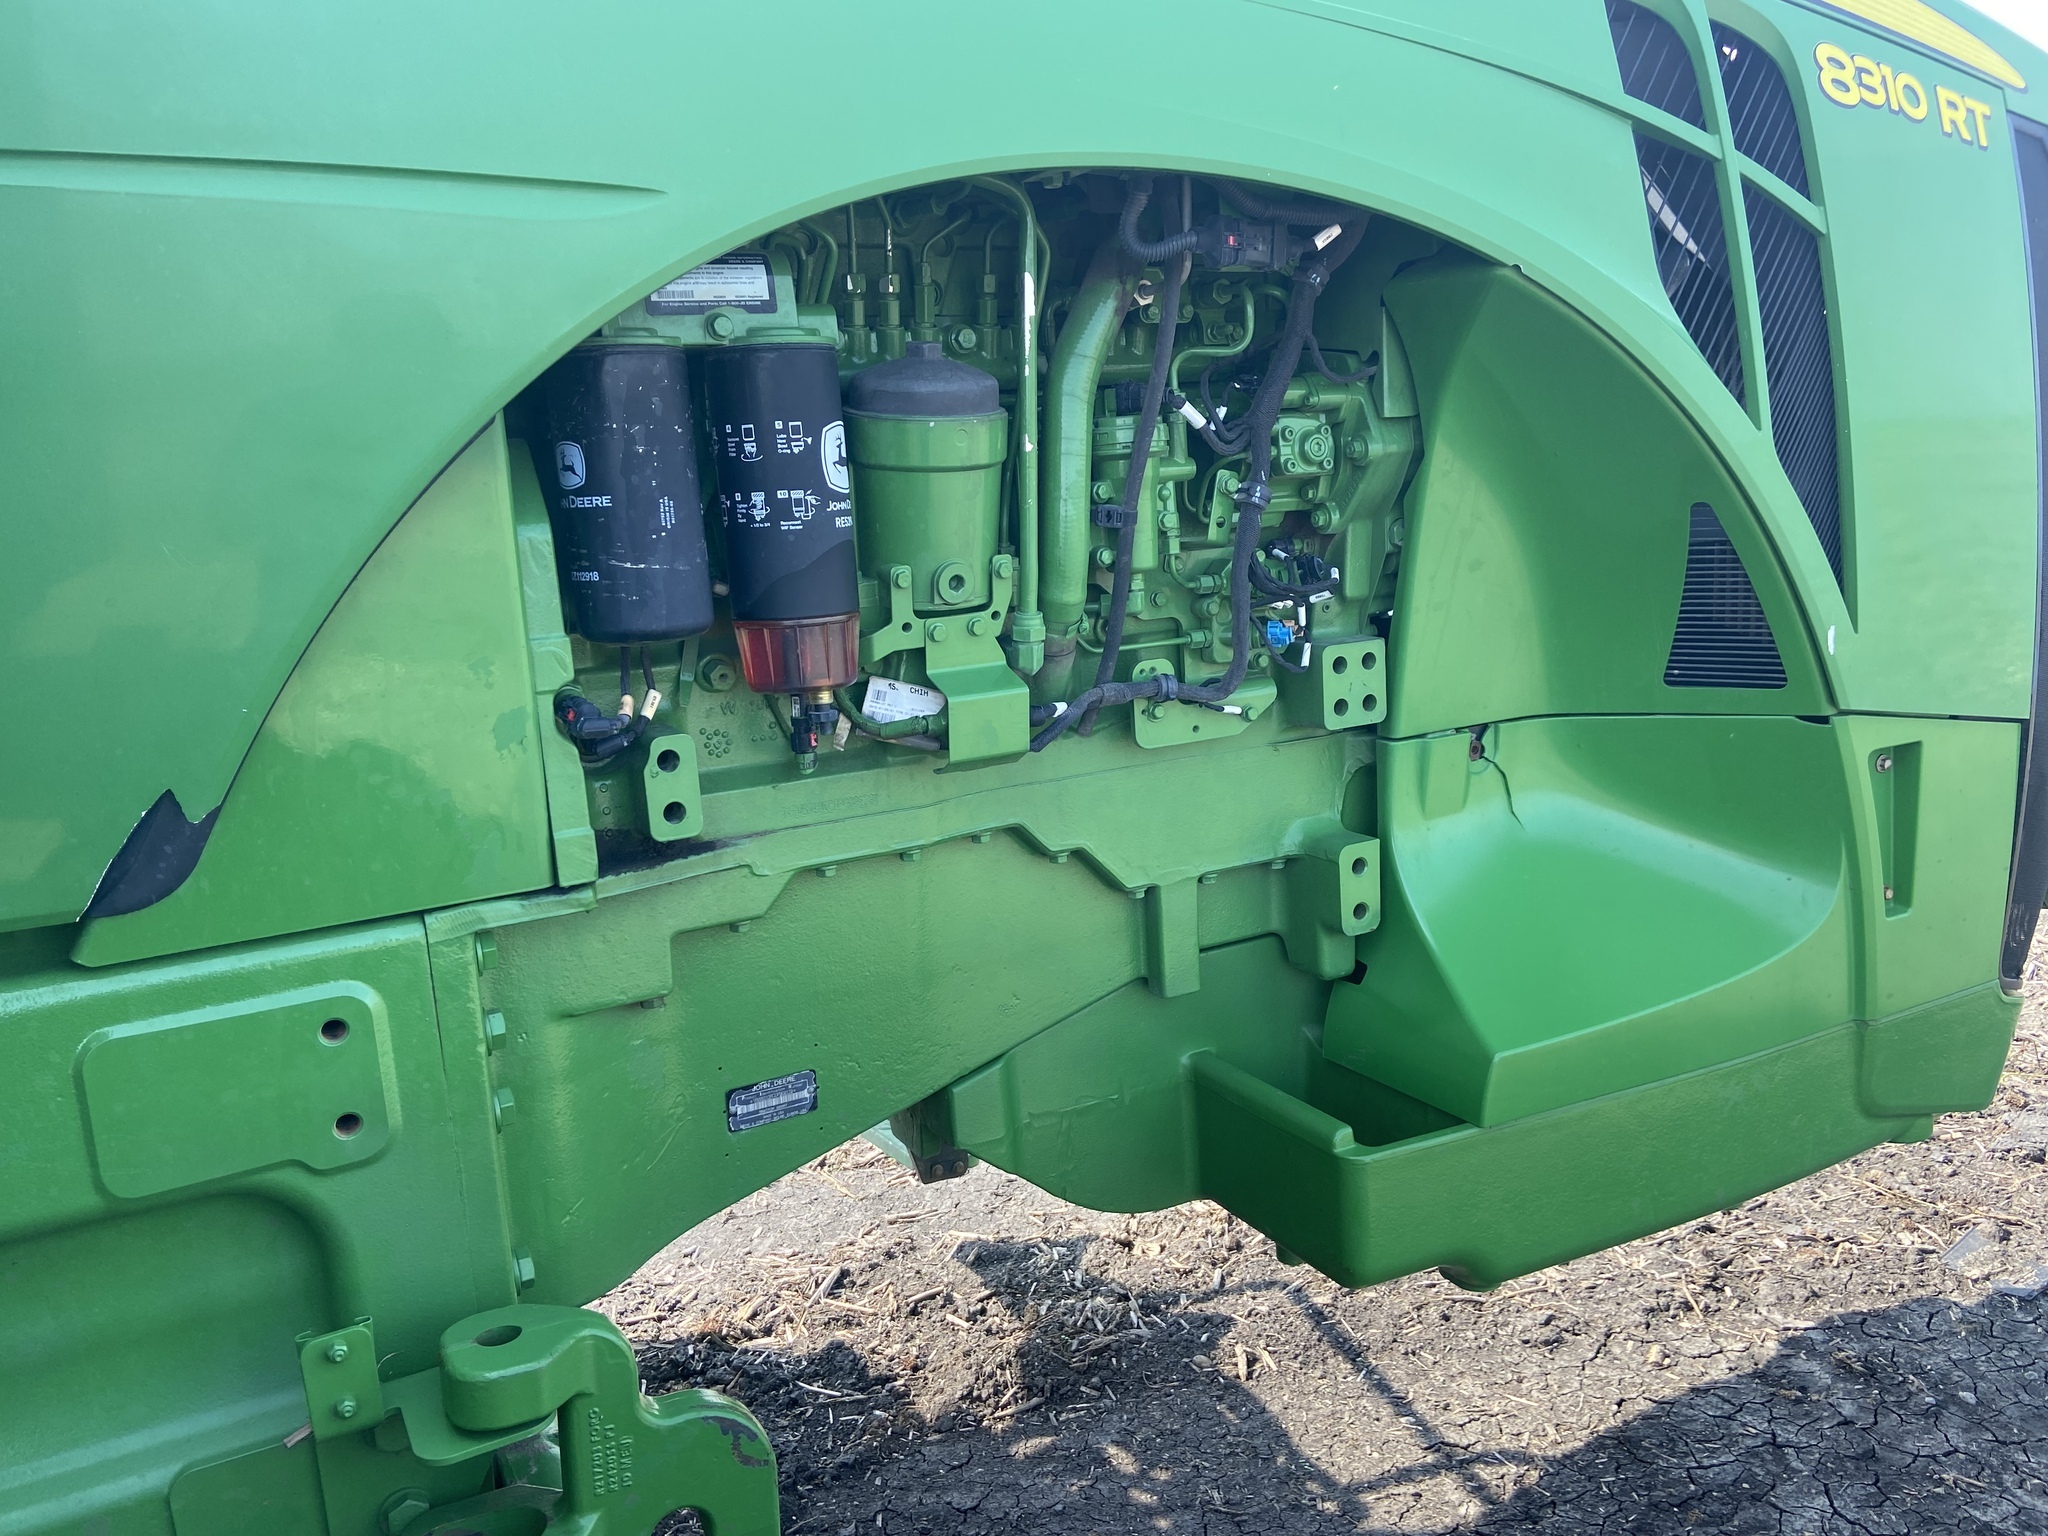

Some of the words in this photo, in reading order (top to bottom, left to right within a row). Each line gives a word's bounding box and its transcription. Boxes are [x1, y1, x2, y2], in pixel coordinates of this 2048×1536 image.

[1813, 41, 1928, 123] 8310
[1934, 82, 1991, 150] RT
[569, 495, 612, 508] DEERE
[826, 500, 847, 511] JOHN
[909, 687, 929, 697] CHIH
[773, 1075, 796, 1087] DEERE
